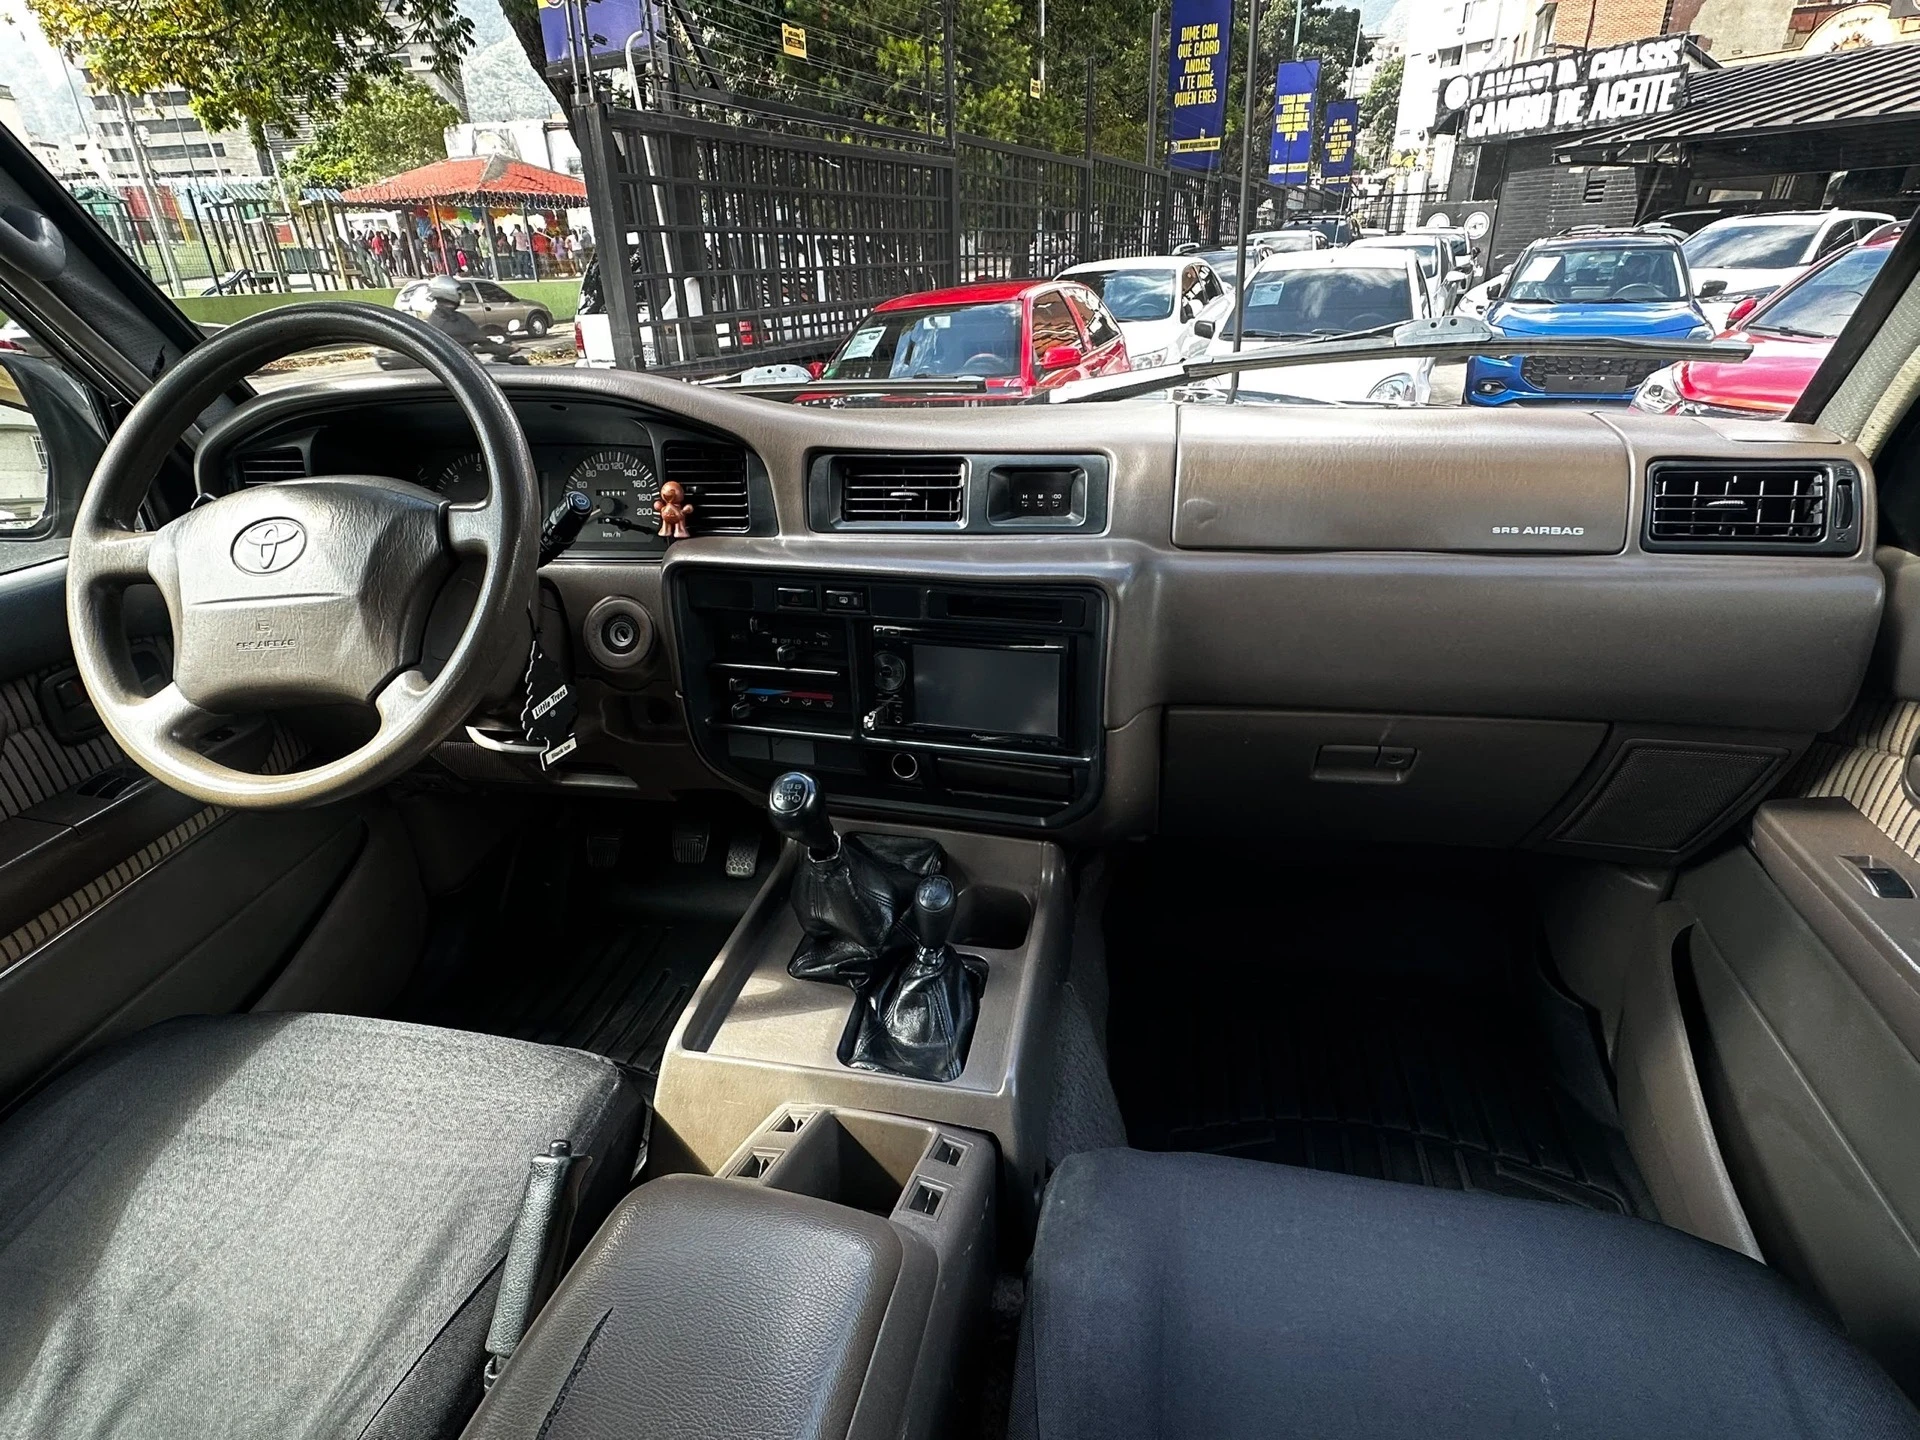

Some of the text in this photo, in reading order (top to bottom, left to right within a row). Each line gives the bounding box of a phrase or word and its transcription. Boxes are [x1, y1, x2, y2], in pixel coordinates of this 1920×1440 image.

[1181, 23, 1219, 41] DIME CON
[1177, 39, 1220, 60] QUÉ CARRO
[1589, 39, 1681, 79] CHASIS
[1184, 57, 1211, 74] ANDAS
[1179, 70, 1214, 90] Y TE DIRÉ
[1174, 89, 1217, 108] QUIÉN ERES
[1467, 72, 1681, 138] CAMBIO DE ACEITE
[475, 463, 482, 472] 3
[596, 462, 624, 471] 100 120
[585, 470, 597, 478] 80
[623, 469, 637, 477] 140
[453, 474, 460, 483] 2
[576, 481, 588, 489] 60
[632, 480, 647, 488] 160
[637, 493, 652, 502] 180
[636, 508, 653, 516] 200
[1492, 526, 1584, 535] SRS AIRBAG
[534, 688, 566, 717] Little Trees
